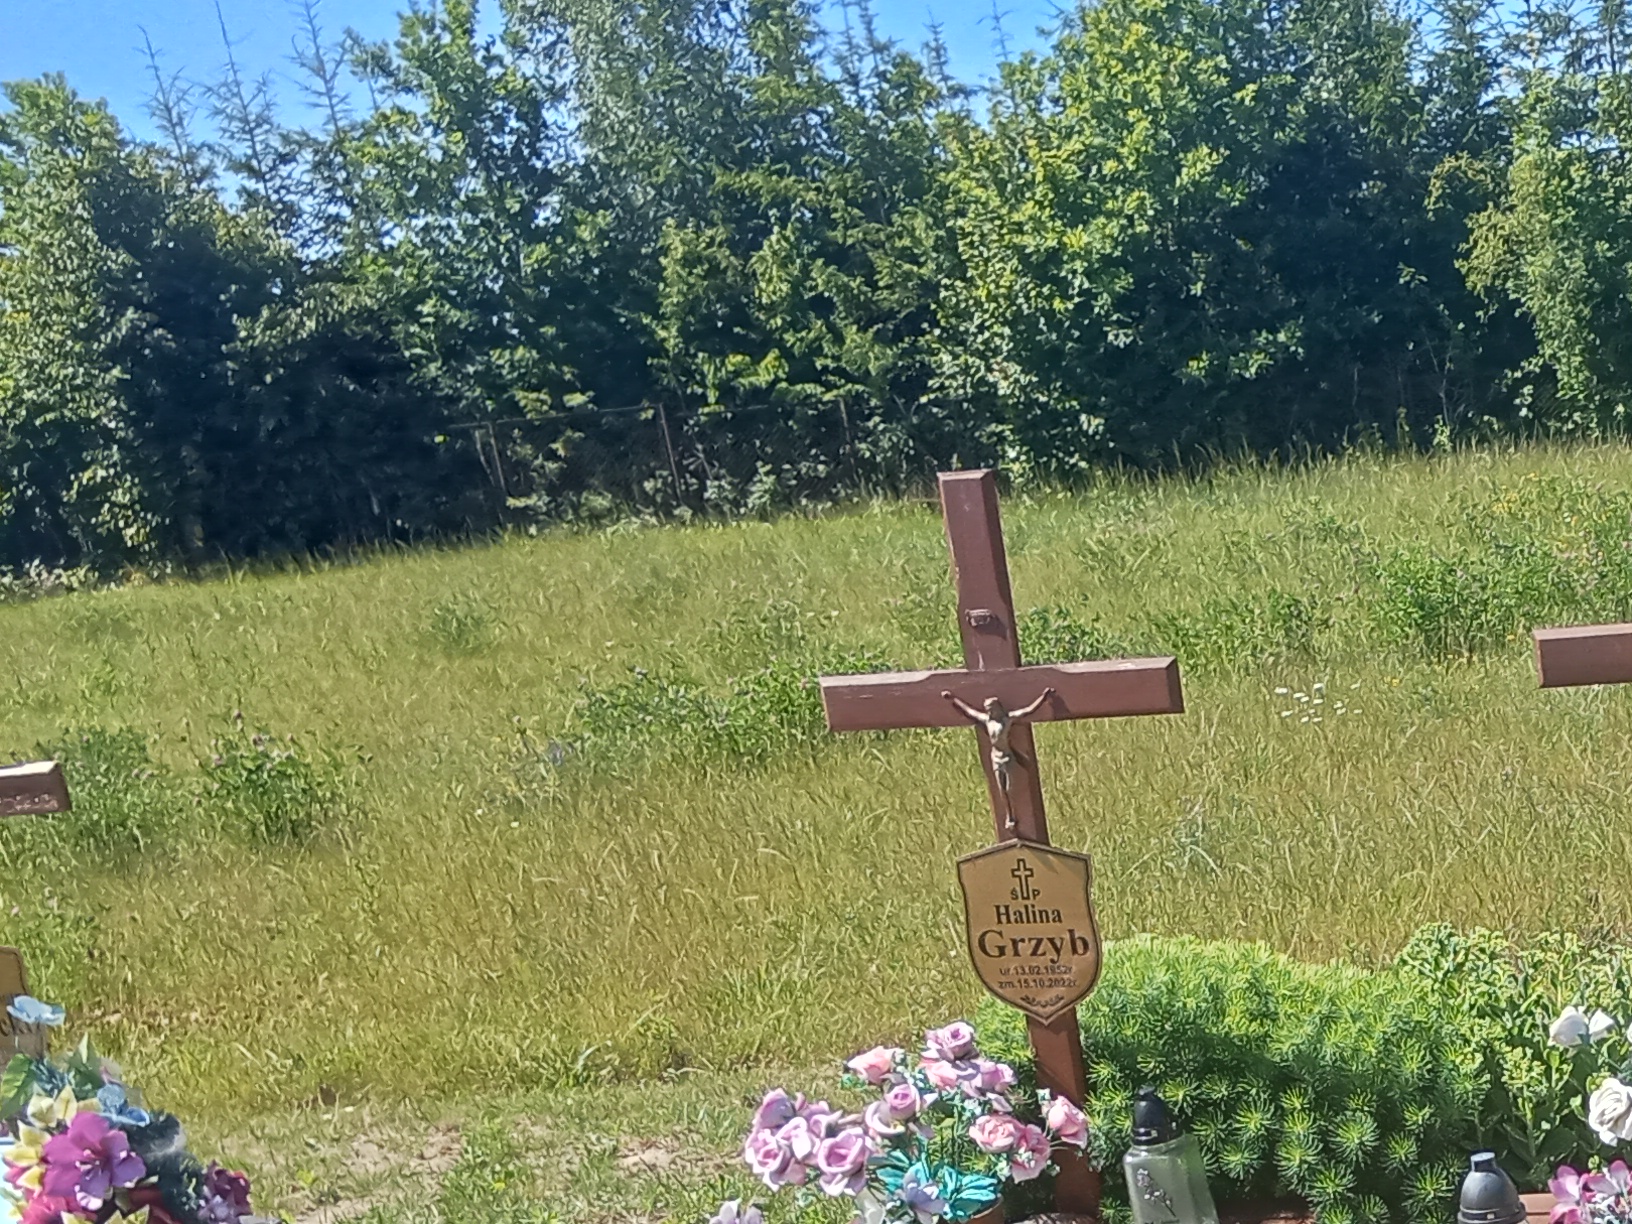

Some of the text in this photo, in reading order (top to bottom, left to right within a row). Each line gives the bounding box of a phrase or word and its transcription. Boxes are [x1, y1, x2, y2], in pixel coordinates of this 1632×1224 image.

[1032, 889, 1041, 901] P
[994, 903, 1063, 925] Halina
[977, 929, 1090, 964] Grzyb
